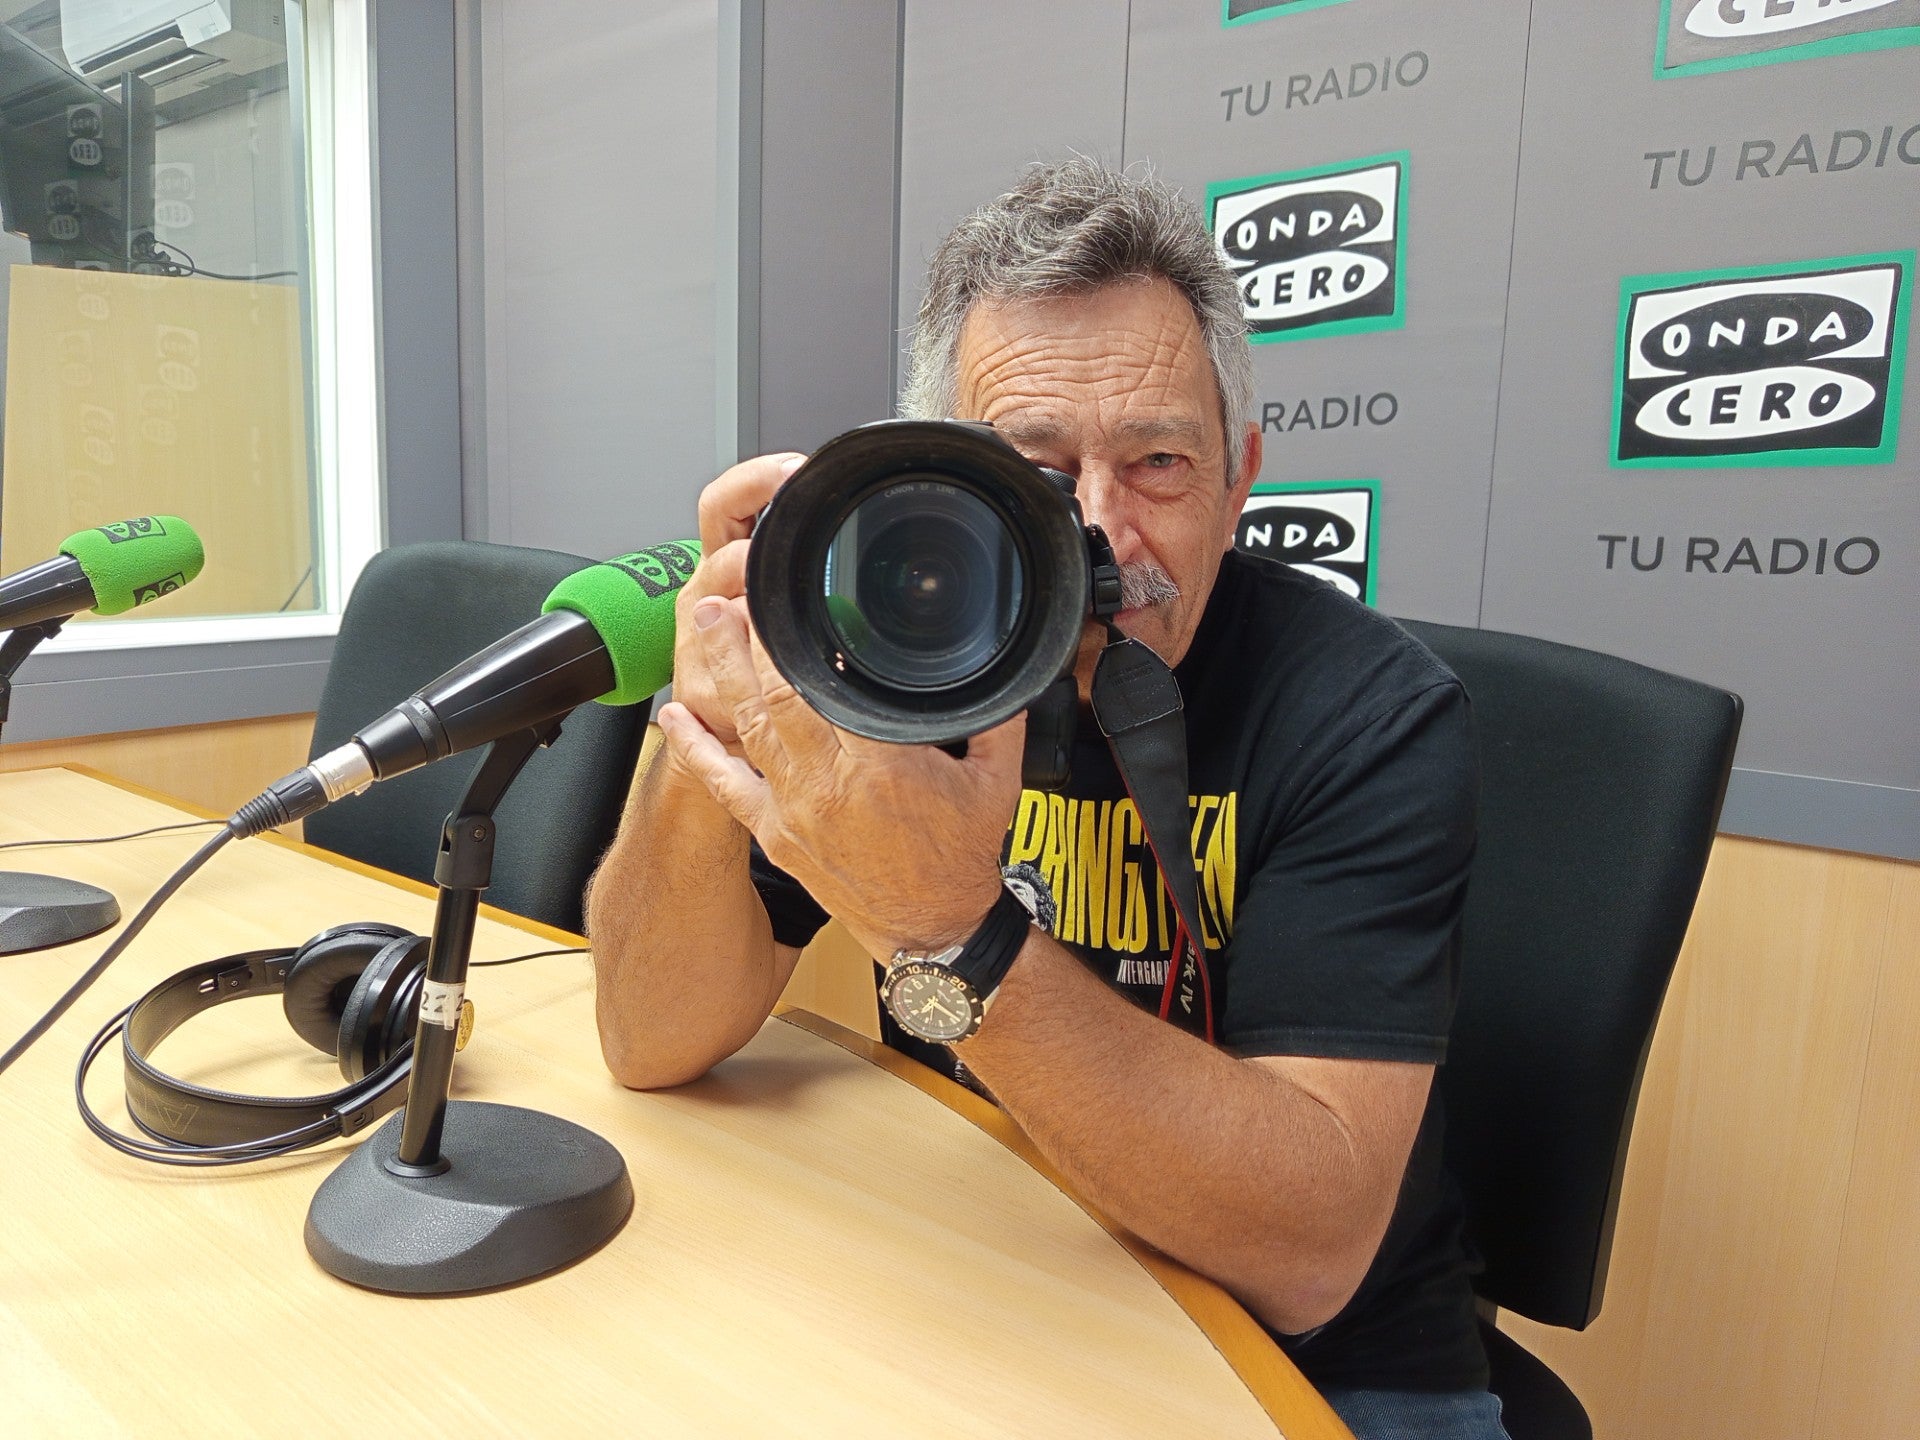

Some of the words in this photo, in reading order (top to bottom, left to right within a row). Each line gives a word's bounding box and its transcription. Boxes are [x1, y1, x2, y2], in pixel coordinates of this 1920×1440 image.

[1221, 80, 1271, 121] TU
[1285, 50, 1429, 109] RADIO
[1643, 146, 1717, 189] TU
[1236, 203, 1367, 251] ONDA
[1242, 264, 1366, 309] CERO
[1662, 311, 1847, 357] ONDA
[1261, 392, 1398, 433] RADIO
[1666, 382, 1843, 427] CERO
[1232, 522, 1340, 548] NDA
[1597, 534, 1665, 572] TU
[1685, 536, 1881, 576] RADIO
